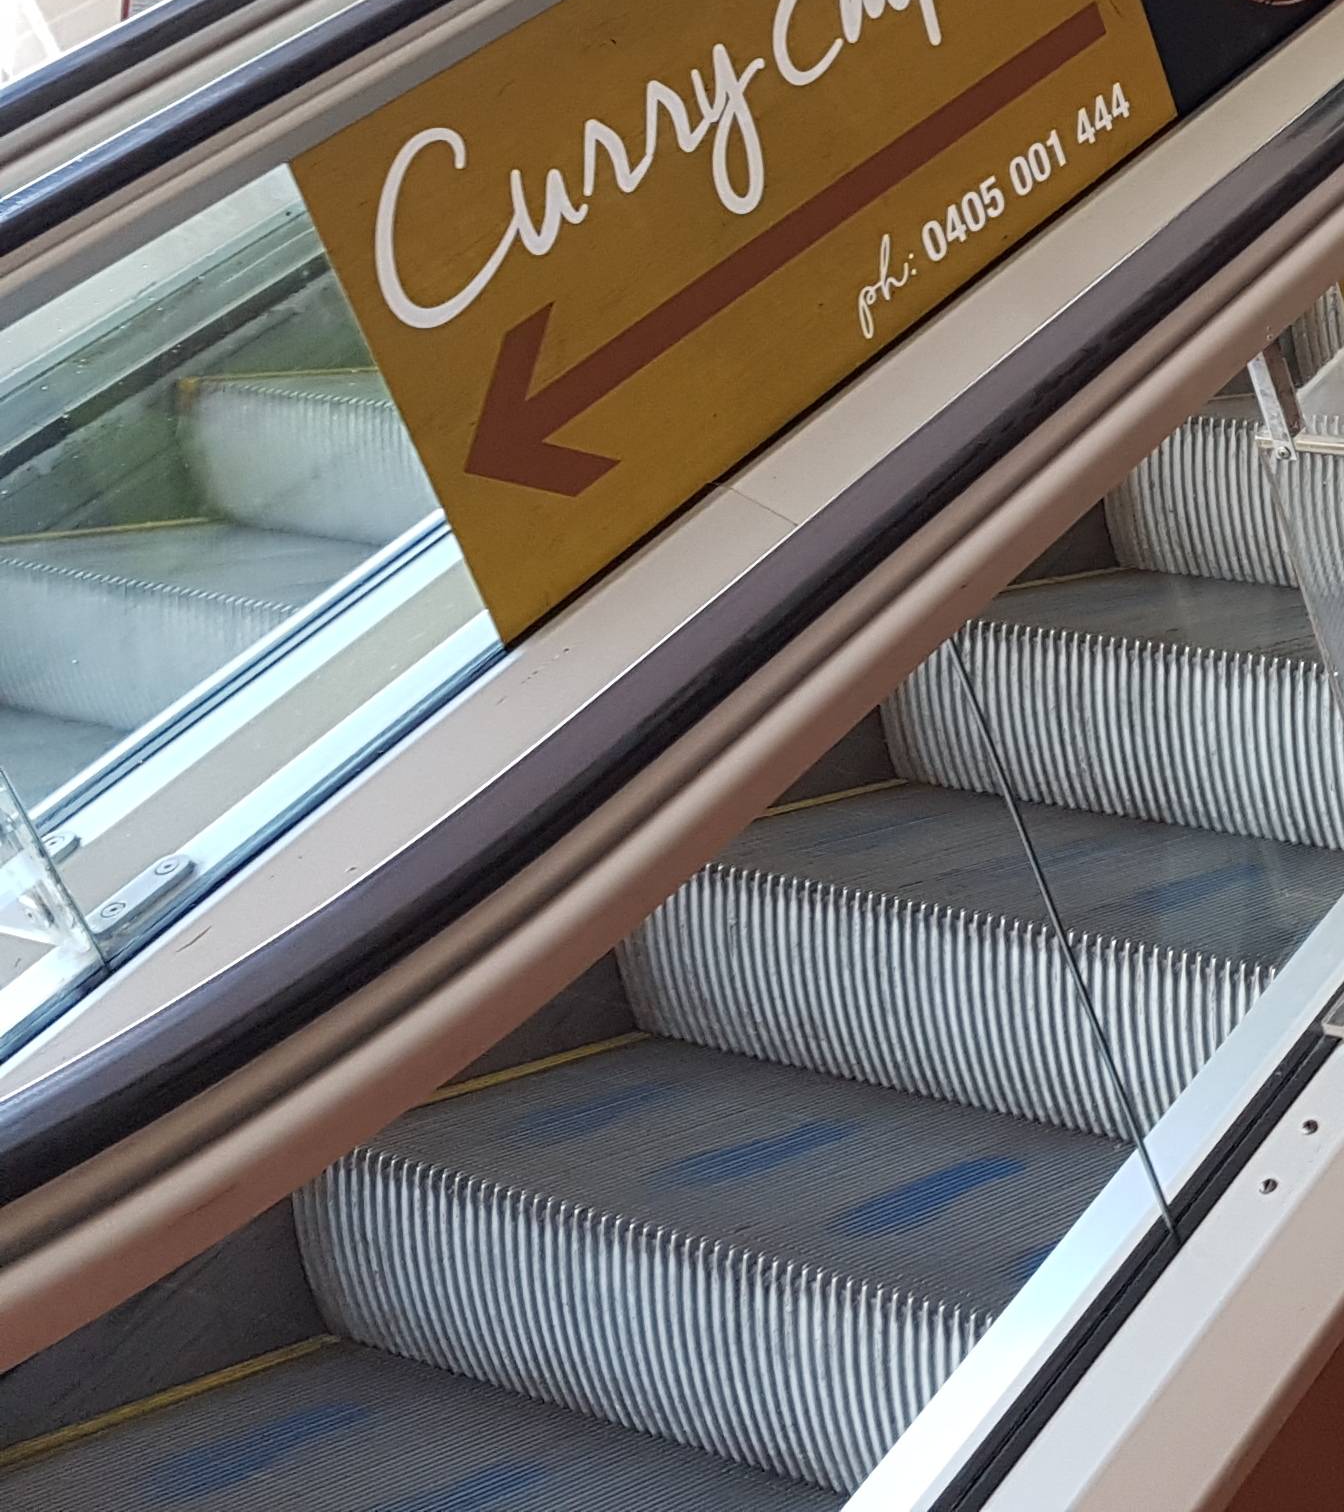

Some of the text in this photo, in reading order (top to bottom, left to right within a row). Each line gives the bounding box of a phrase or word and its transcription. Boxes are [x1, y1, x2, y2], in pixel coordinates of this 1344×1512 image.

[374, 43, 766, 330] Curry
[856, 81, 1130, 339] ph: 0405 001 444
